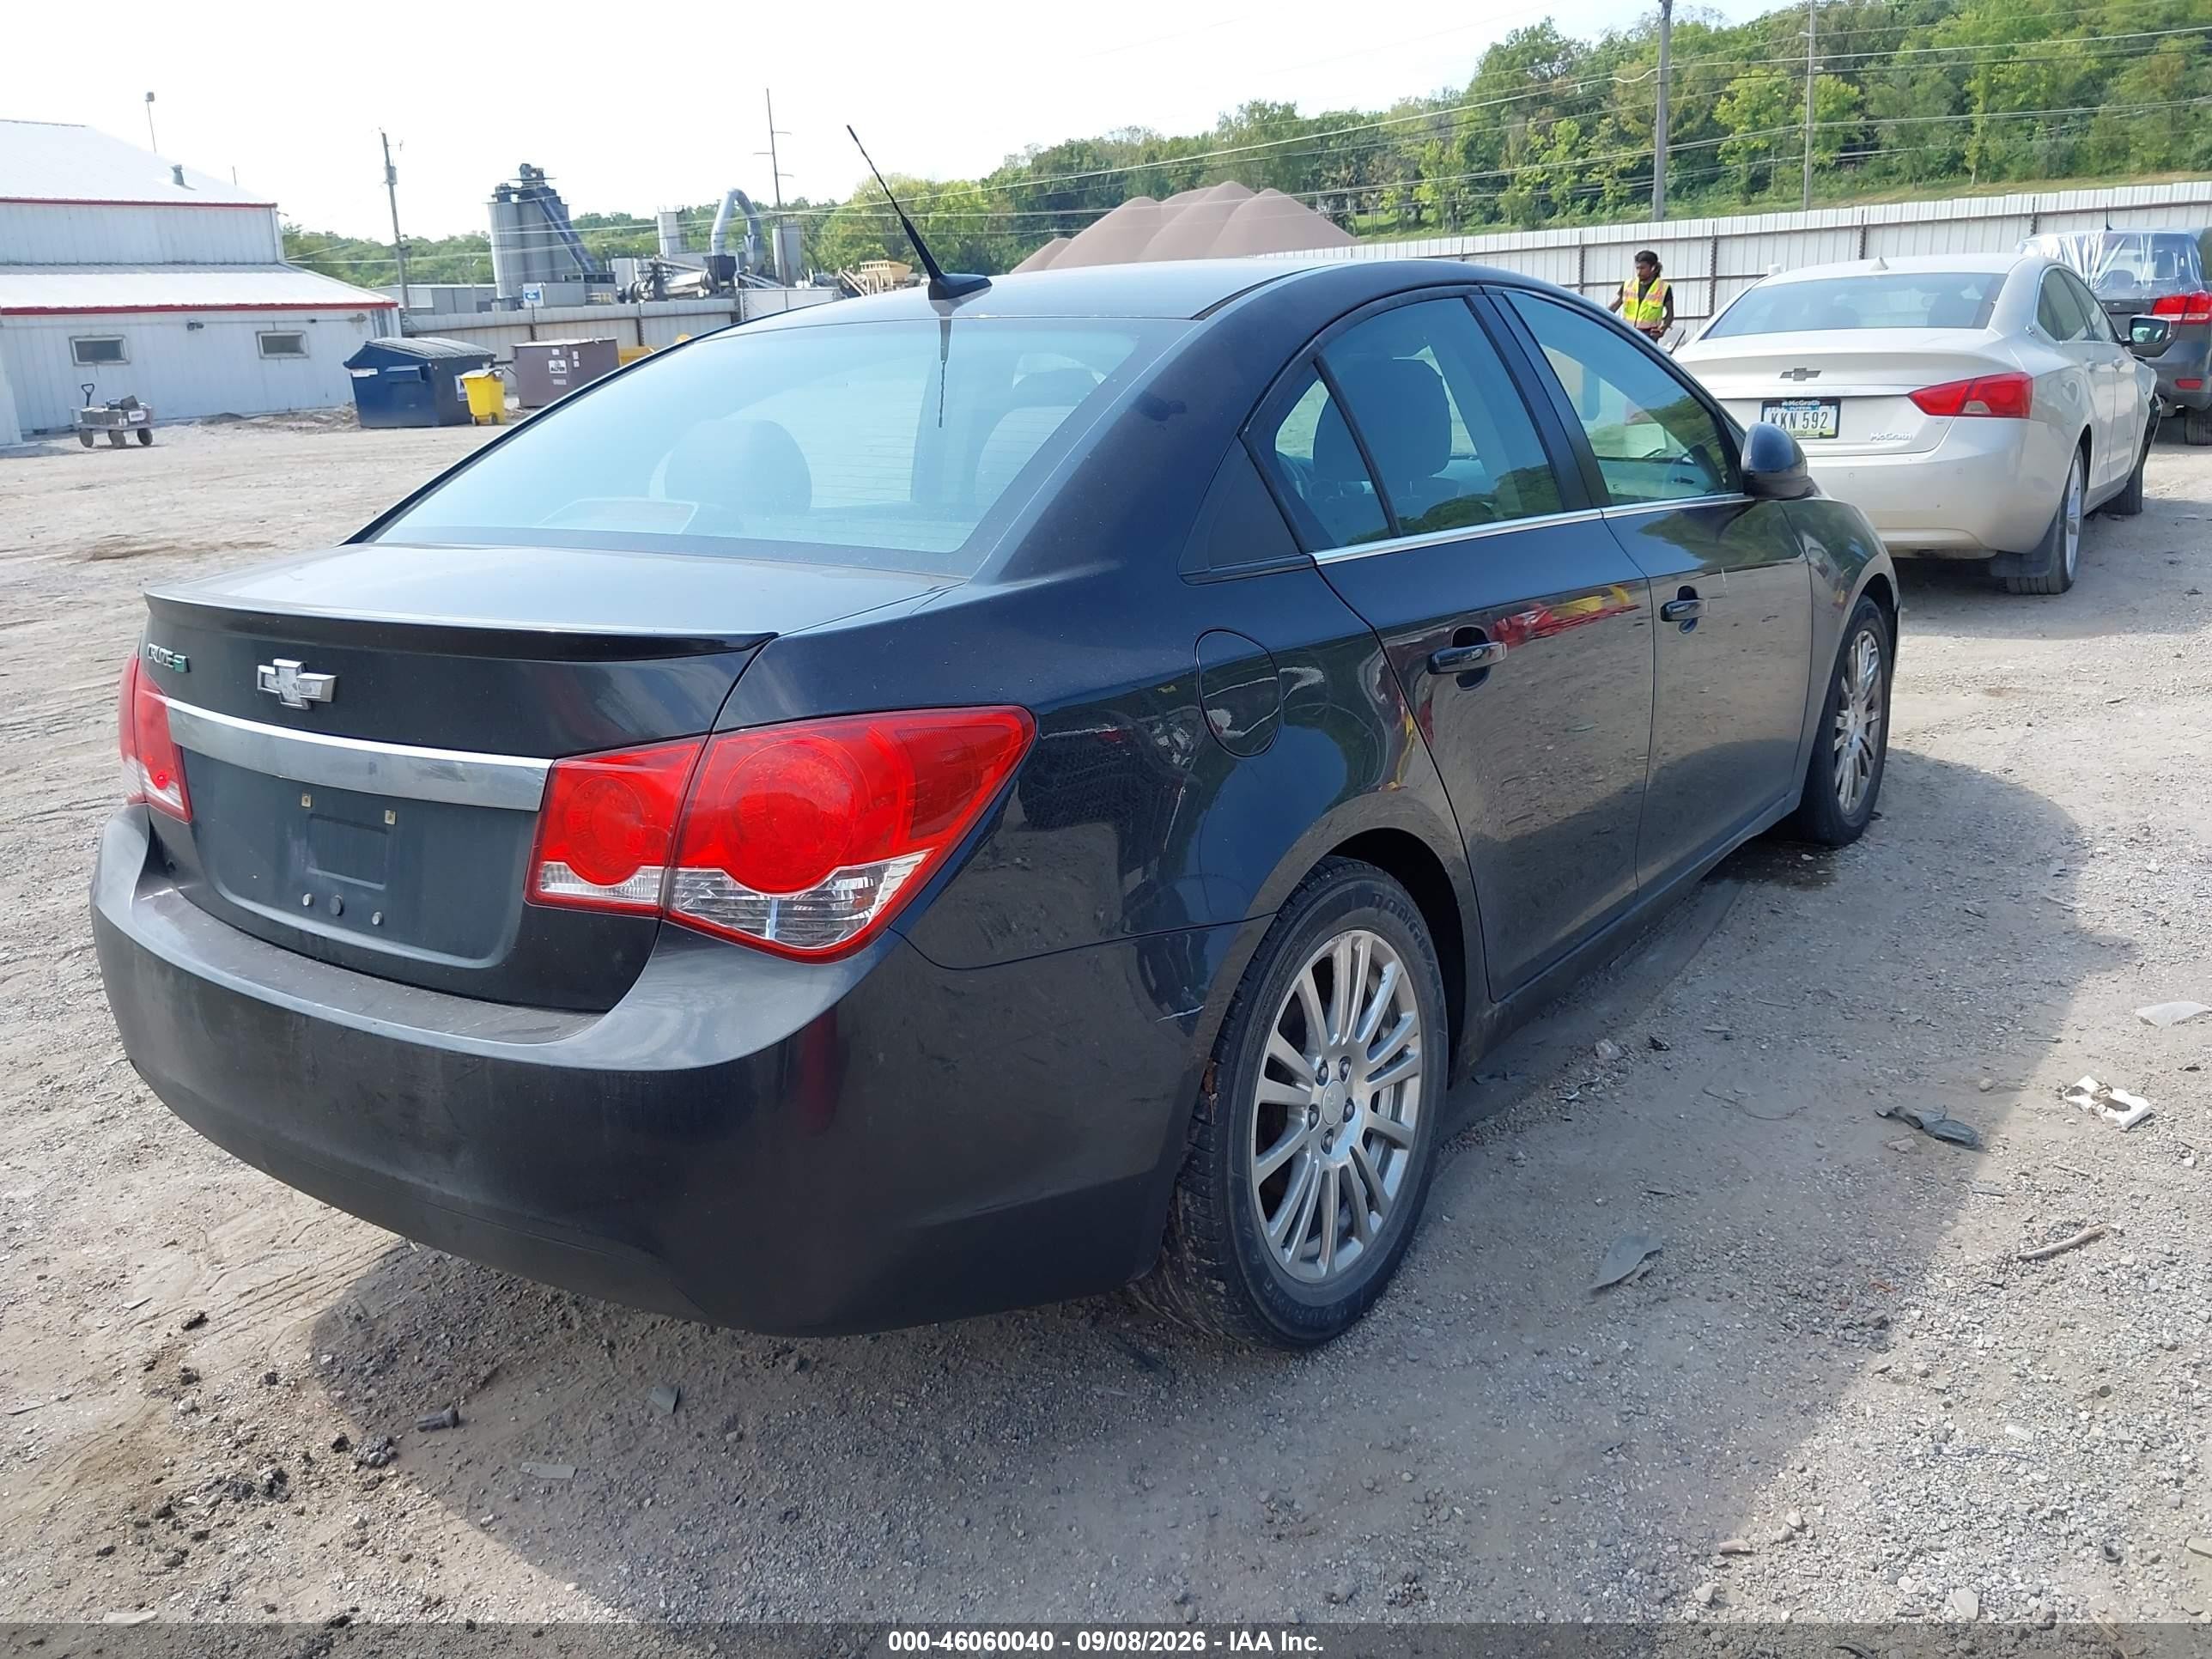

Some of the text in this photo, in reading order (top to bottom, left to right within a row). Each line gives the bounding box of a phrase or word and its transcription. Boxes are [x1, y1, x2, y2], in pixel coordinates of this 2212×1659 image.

[1771, 411, 1829, 429] KKN 592
[1869, 432, 1912, 441] McGrath
